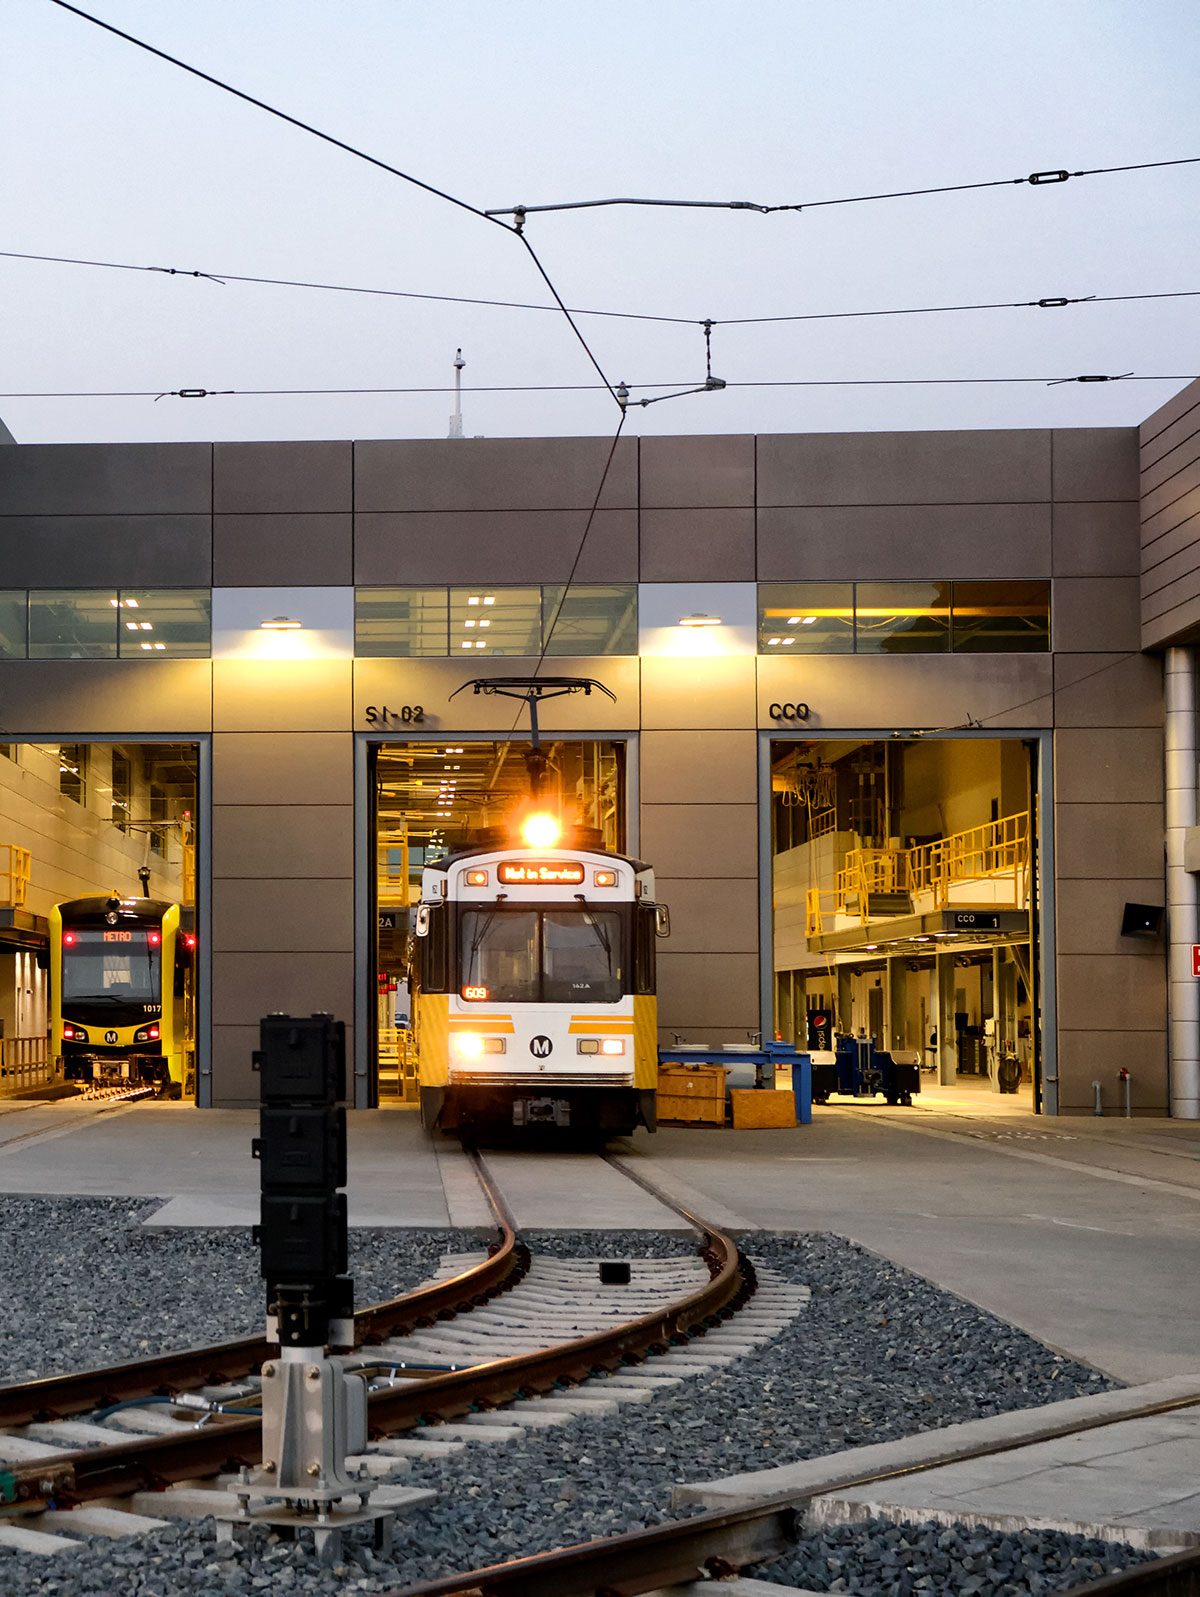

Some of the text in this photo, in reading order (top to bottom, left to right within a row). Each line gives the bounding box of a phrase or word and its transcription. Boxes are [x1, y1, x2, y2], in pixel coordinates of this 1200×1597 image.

[365, 705, 424, 723] SI-02
[504, 866, 581, 880] Not in Service
[957, 914, 998, 928] CCO 1
[103, 931, 132, 942] METRO
[465, 986, 487, 999] 609
[143, 1004, 162, 1013] 1017
[533, 1039, 550, 1055] M
